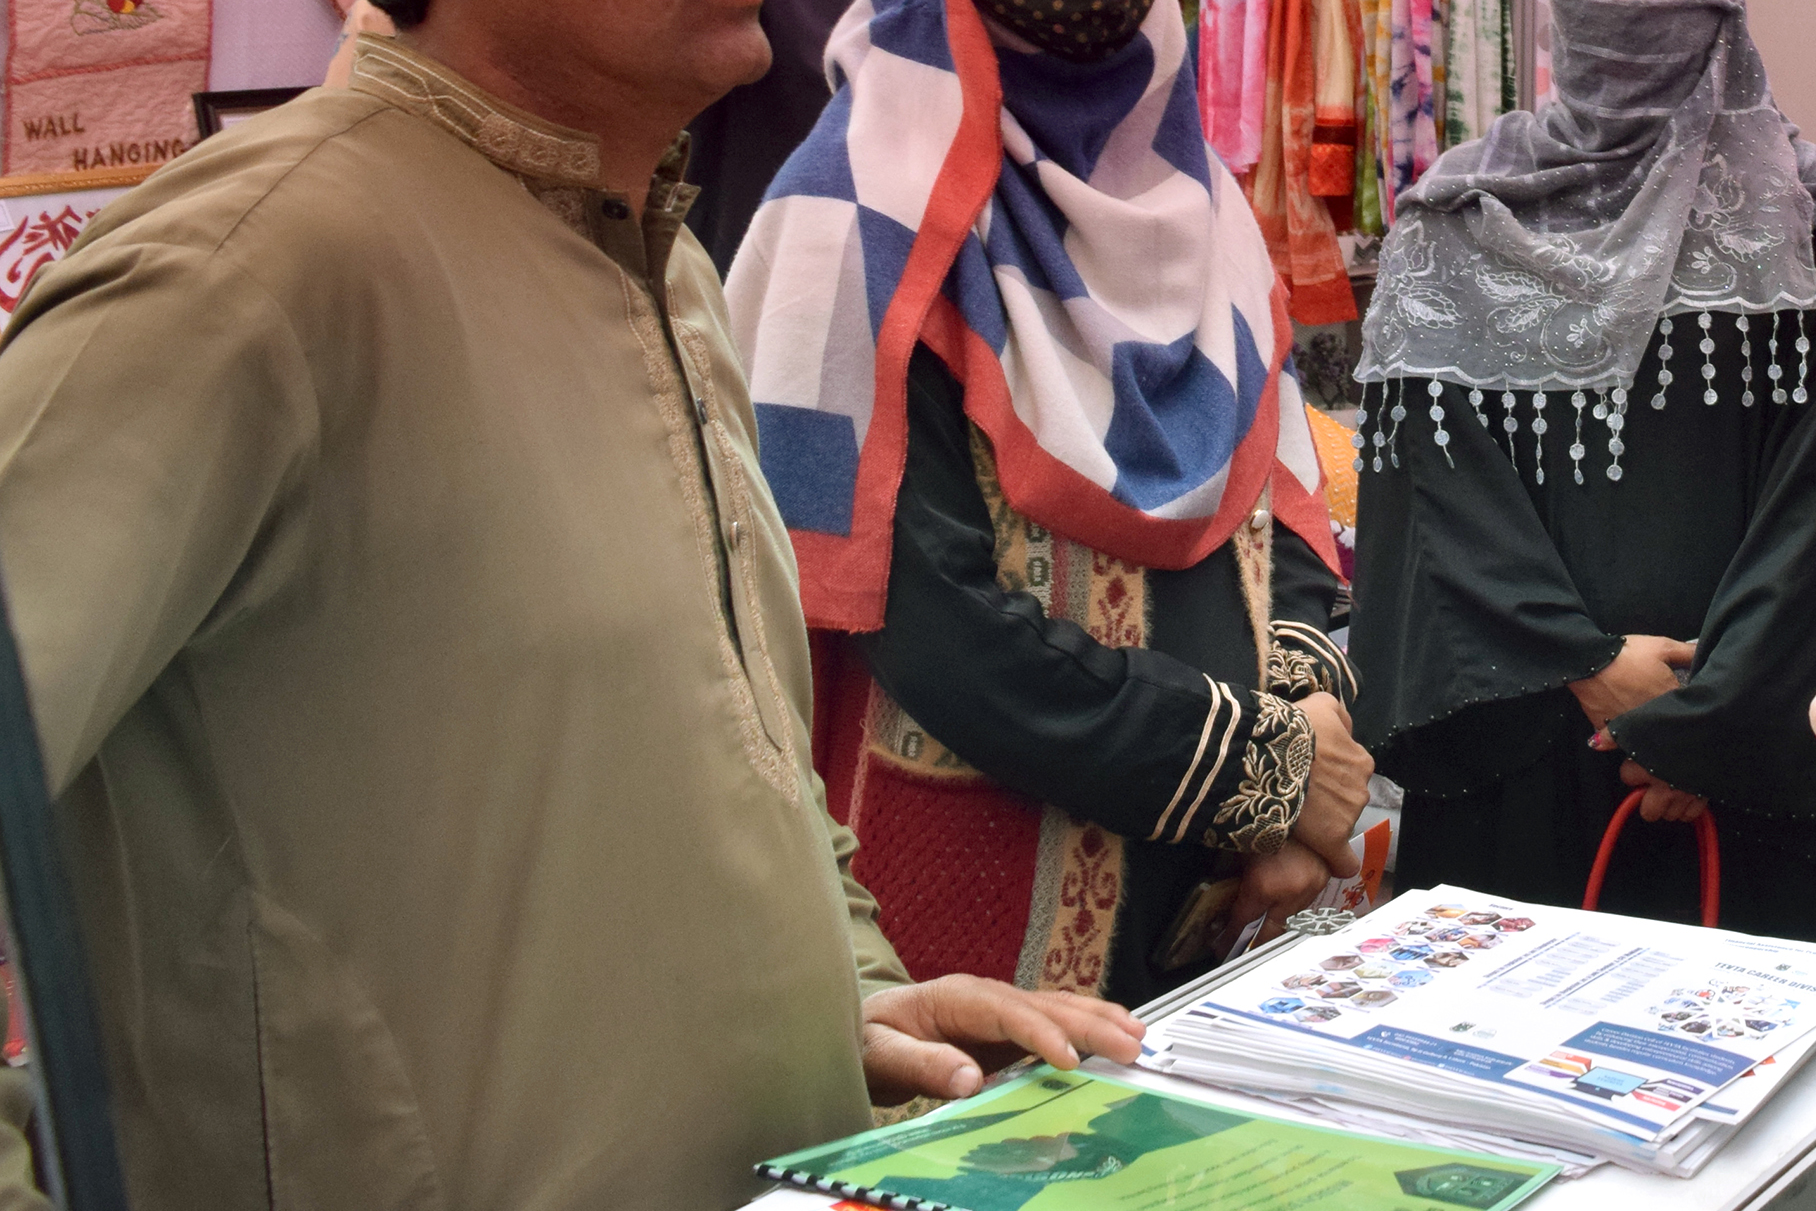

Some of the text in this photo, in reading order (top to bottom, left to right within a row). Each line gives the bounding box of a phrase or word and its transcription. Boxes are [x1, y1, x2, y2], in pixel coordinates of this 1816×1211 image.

[23, 113, 86, 141] WALL
[1715, 962, 1747, 973] TEVTA
[1747, 969, 1788, 985] CAREER
